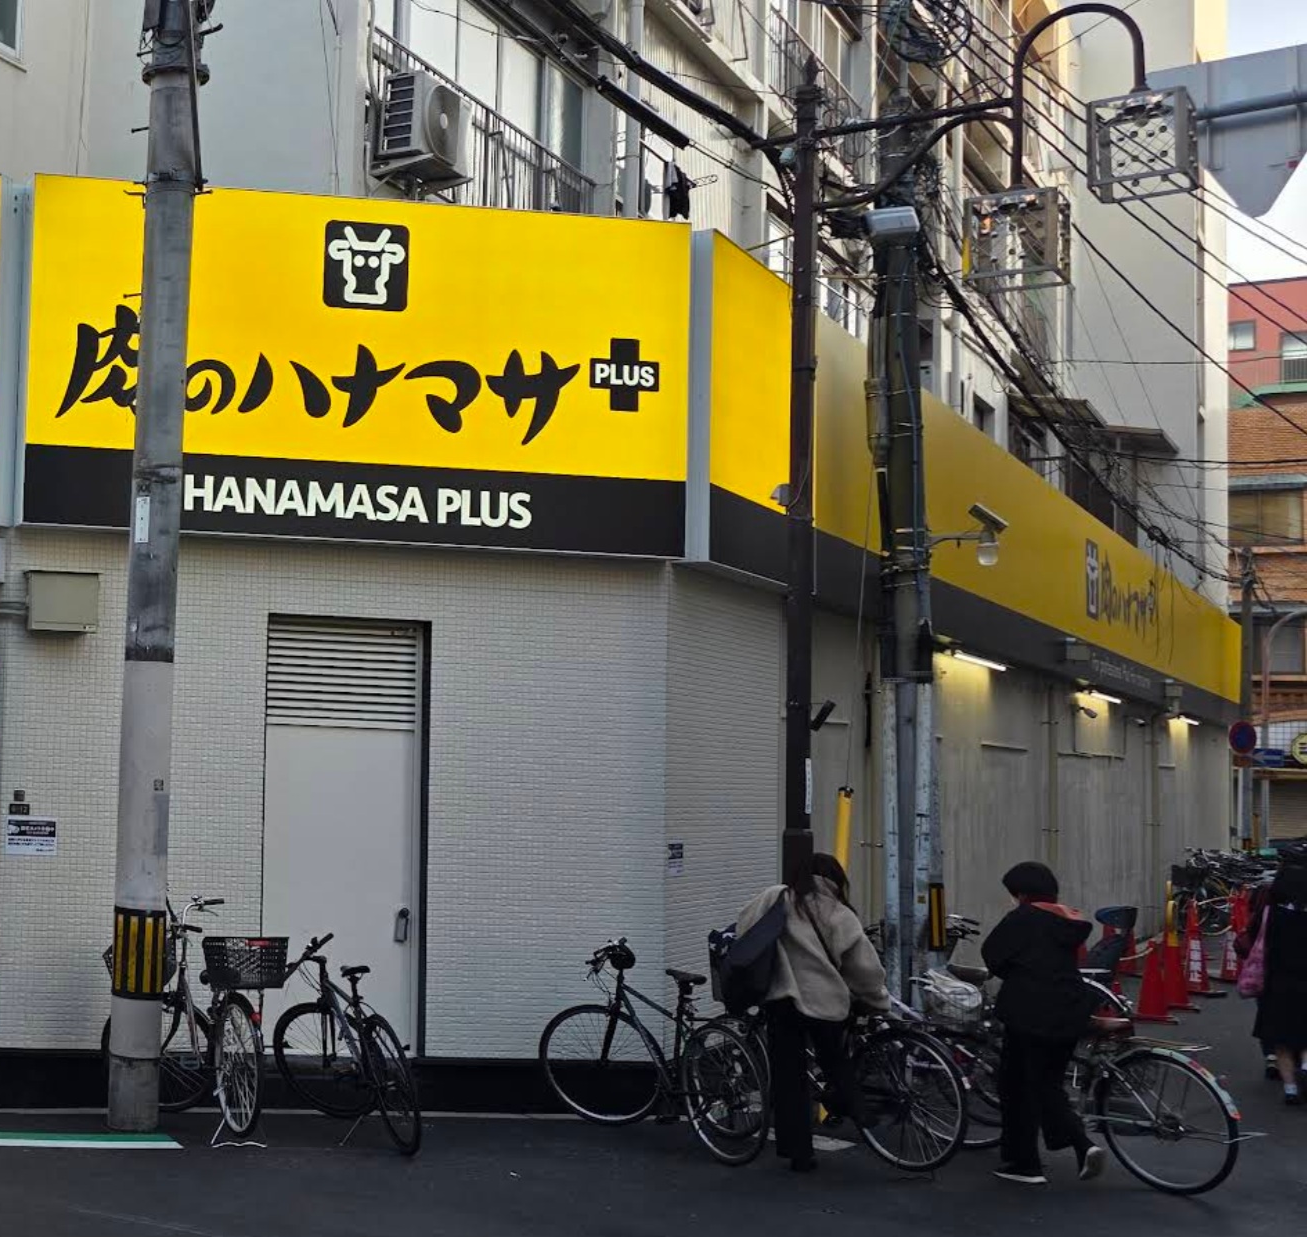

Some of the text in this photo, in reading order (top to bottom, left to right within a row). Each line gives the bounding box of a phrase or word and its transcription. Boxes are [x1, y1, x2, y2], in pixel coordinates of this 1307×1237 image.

[595, 363, 655, 387] PLUS
[184, 474, 532, 529] HANAMASA PLUS
